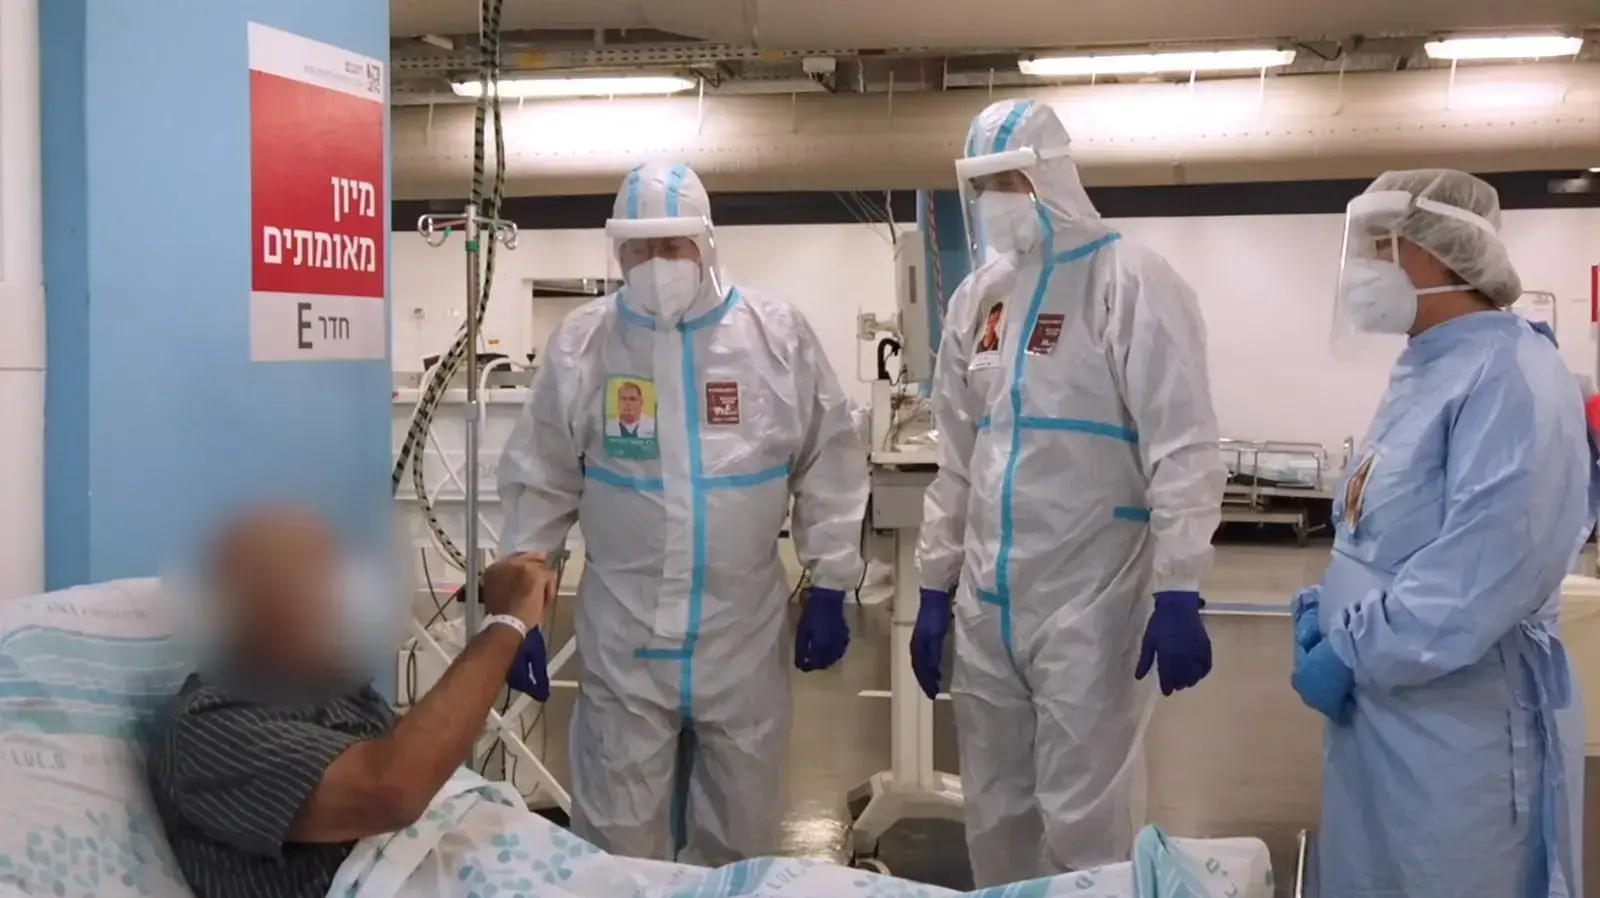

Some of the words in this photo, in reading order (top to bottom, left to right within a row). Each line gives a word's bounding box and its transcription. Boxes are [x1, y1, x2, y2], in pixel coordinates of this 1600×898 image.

[331, 176, 376, 222] מיון
[263, 225, 376, 273] מאומתים
[297, 302, 313, 349] E
[318, 316, 350, 340] חדר
